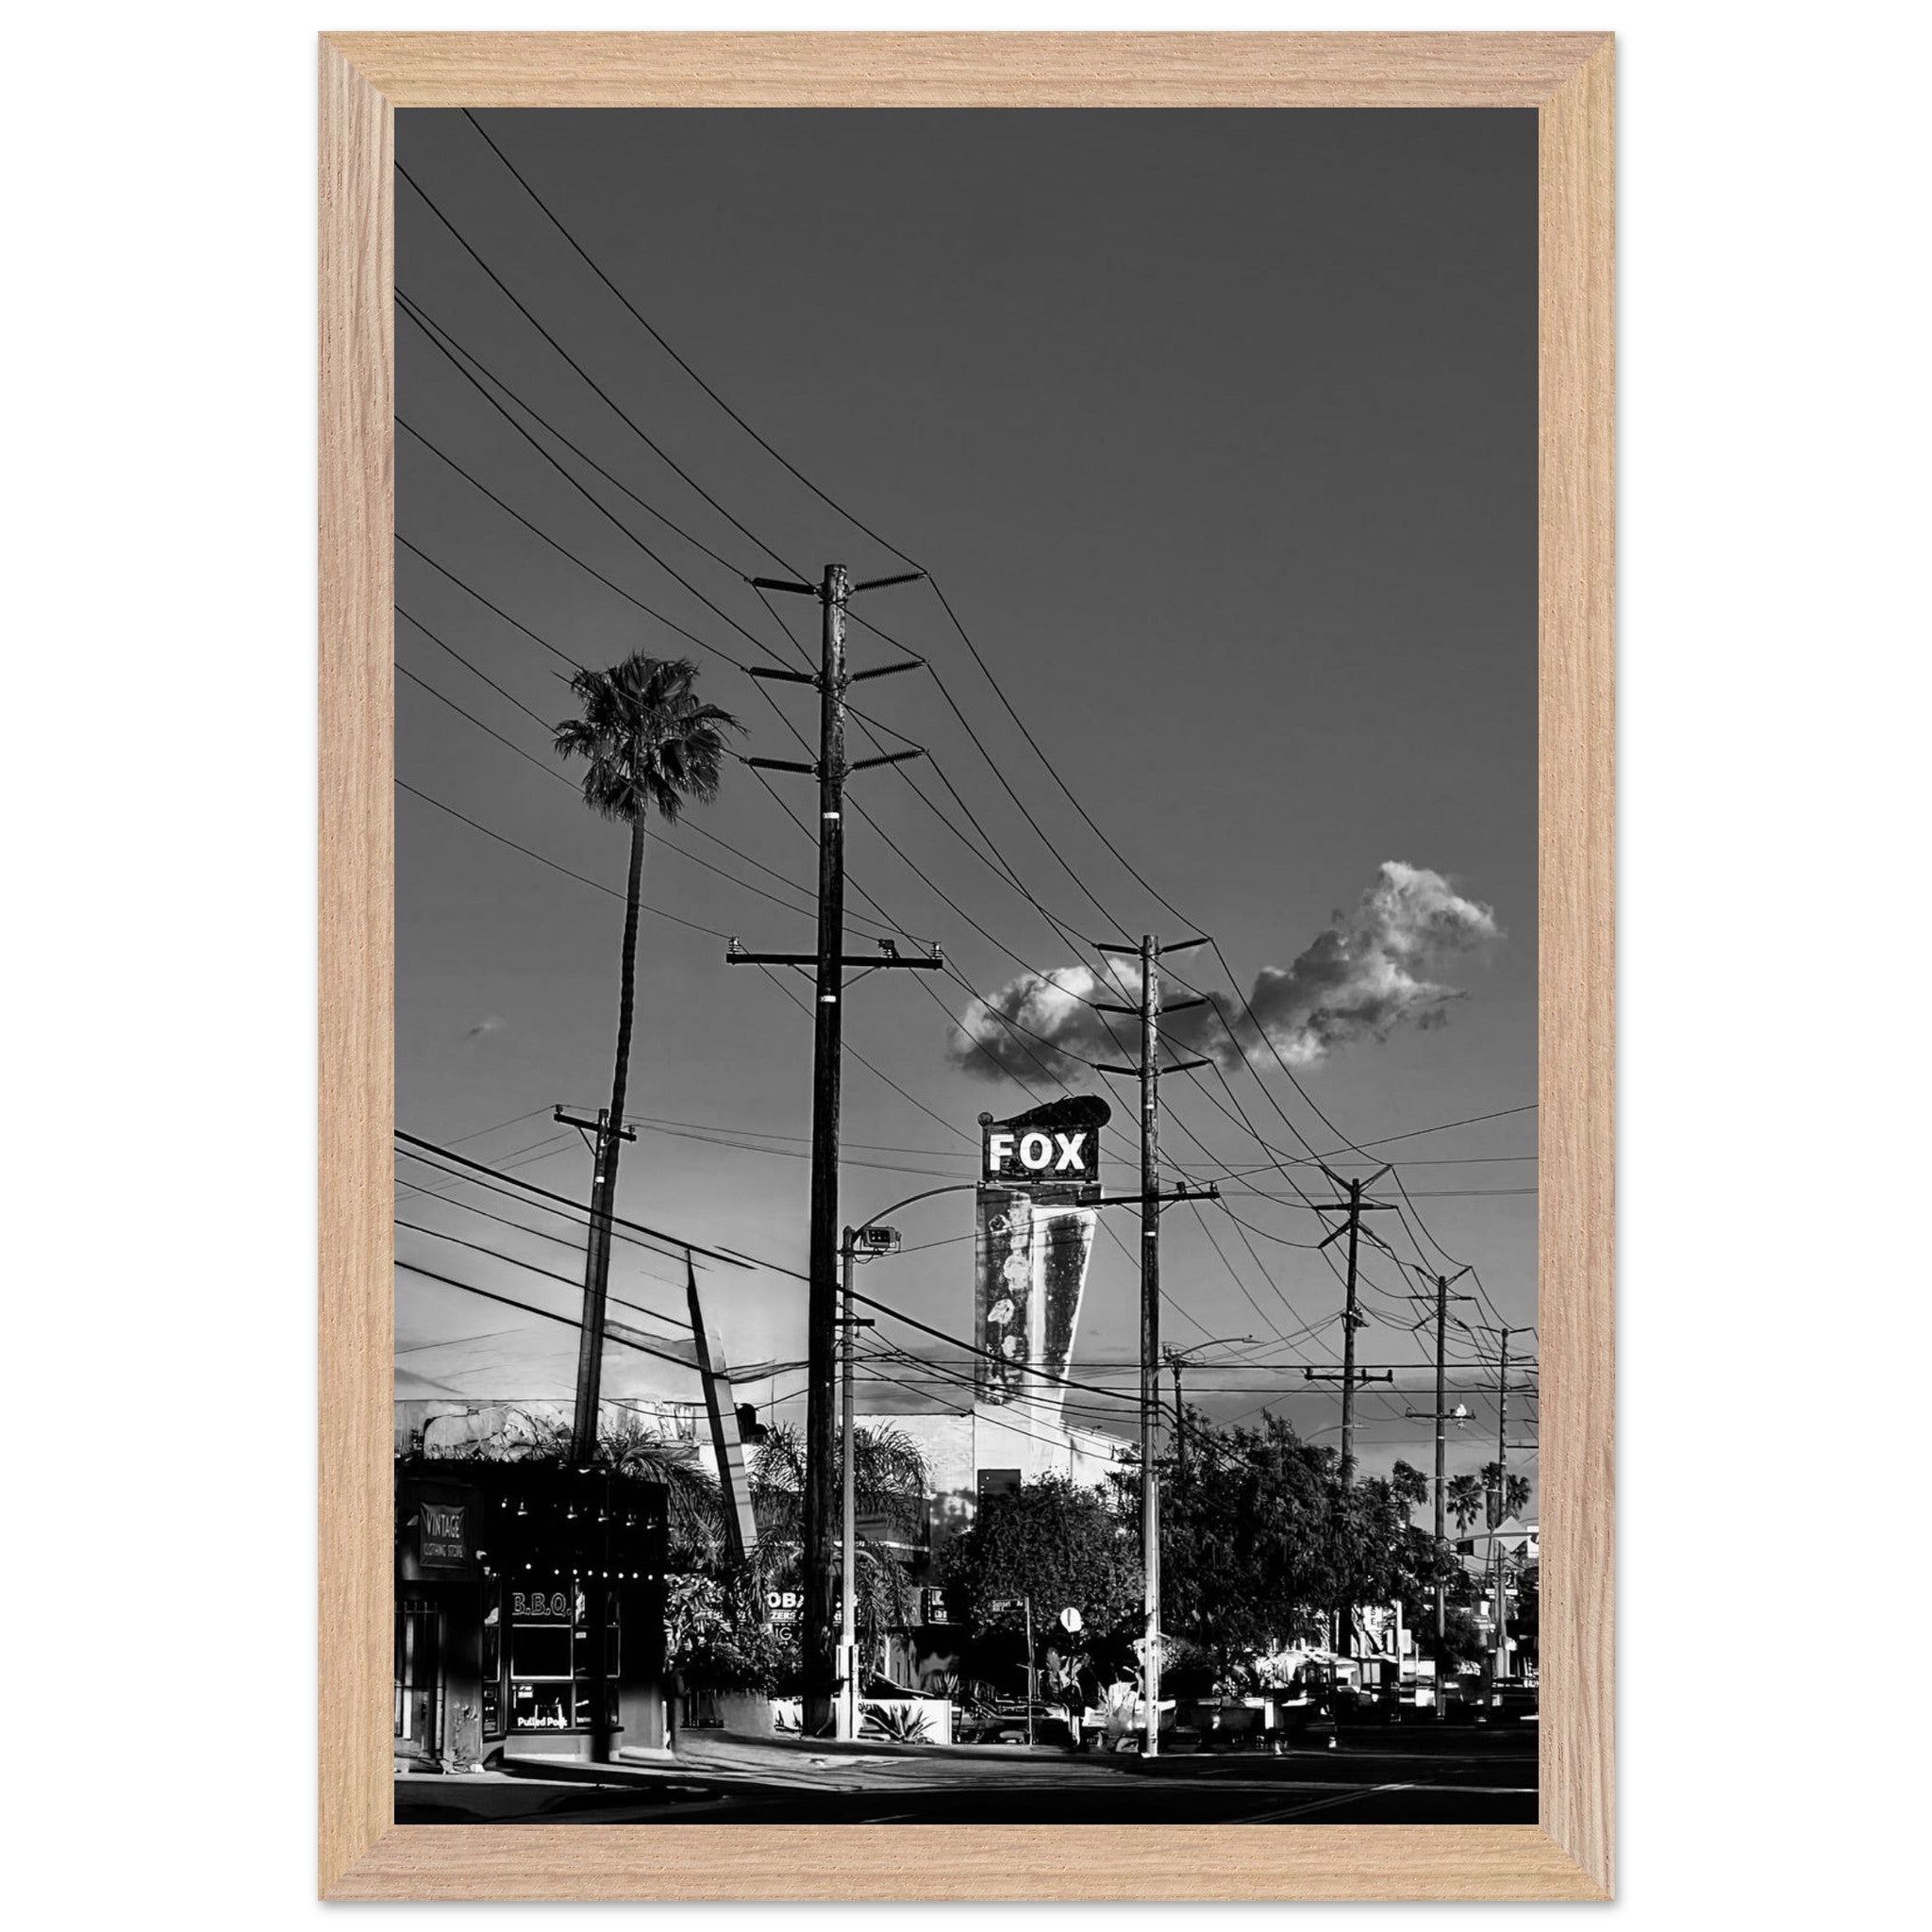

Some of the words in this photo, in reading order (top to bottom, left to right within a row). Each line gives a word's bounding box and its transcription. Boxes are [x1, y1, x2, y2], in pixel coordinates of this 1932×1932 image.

[990, 1132, 1088, 1171] FOX
[426, 1512, 460, 1539] VINTAGE
[511, 1592, 573, 1618] B.B.Q.
[517, 1716, 546, 1727] Pulled
